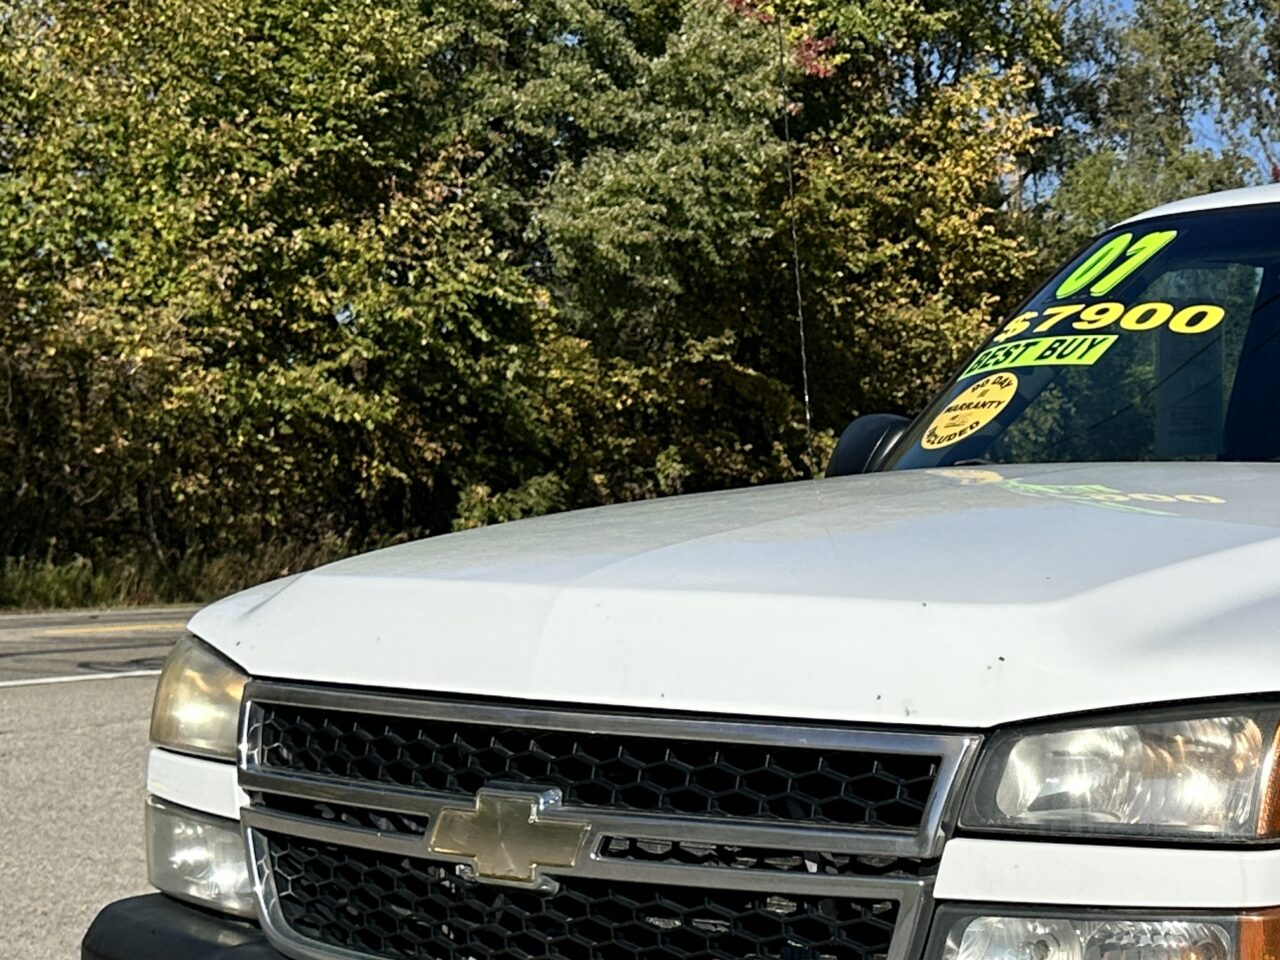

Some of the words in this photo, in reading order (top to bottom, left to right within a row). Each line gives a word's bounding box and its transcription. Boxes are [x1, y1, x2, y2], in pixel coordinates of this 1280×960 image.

[993, 302, 1226, 342] $7900
[965, 340, 1042, 375] BEST
[1034, 337, 1110, 362] BUY
[992, 375, 1014, 390] DAY
[943, 400, 1006, 414] WARRANTY
